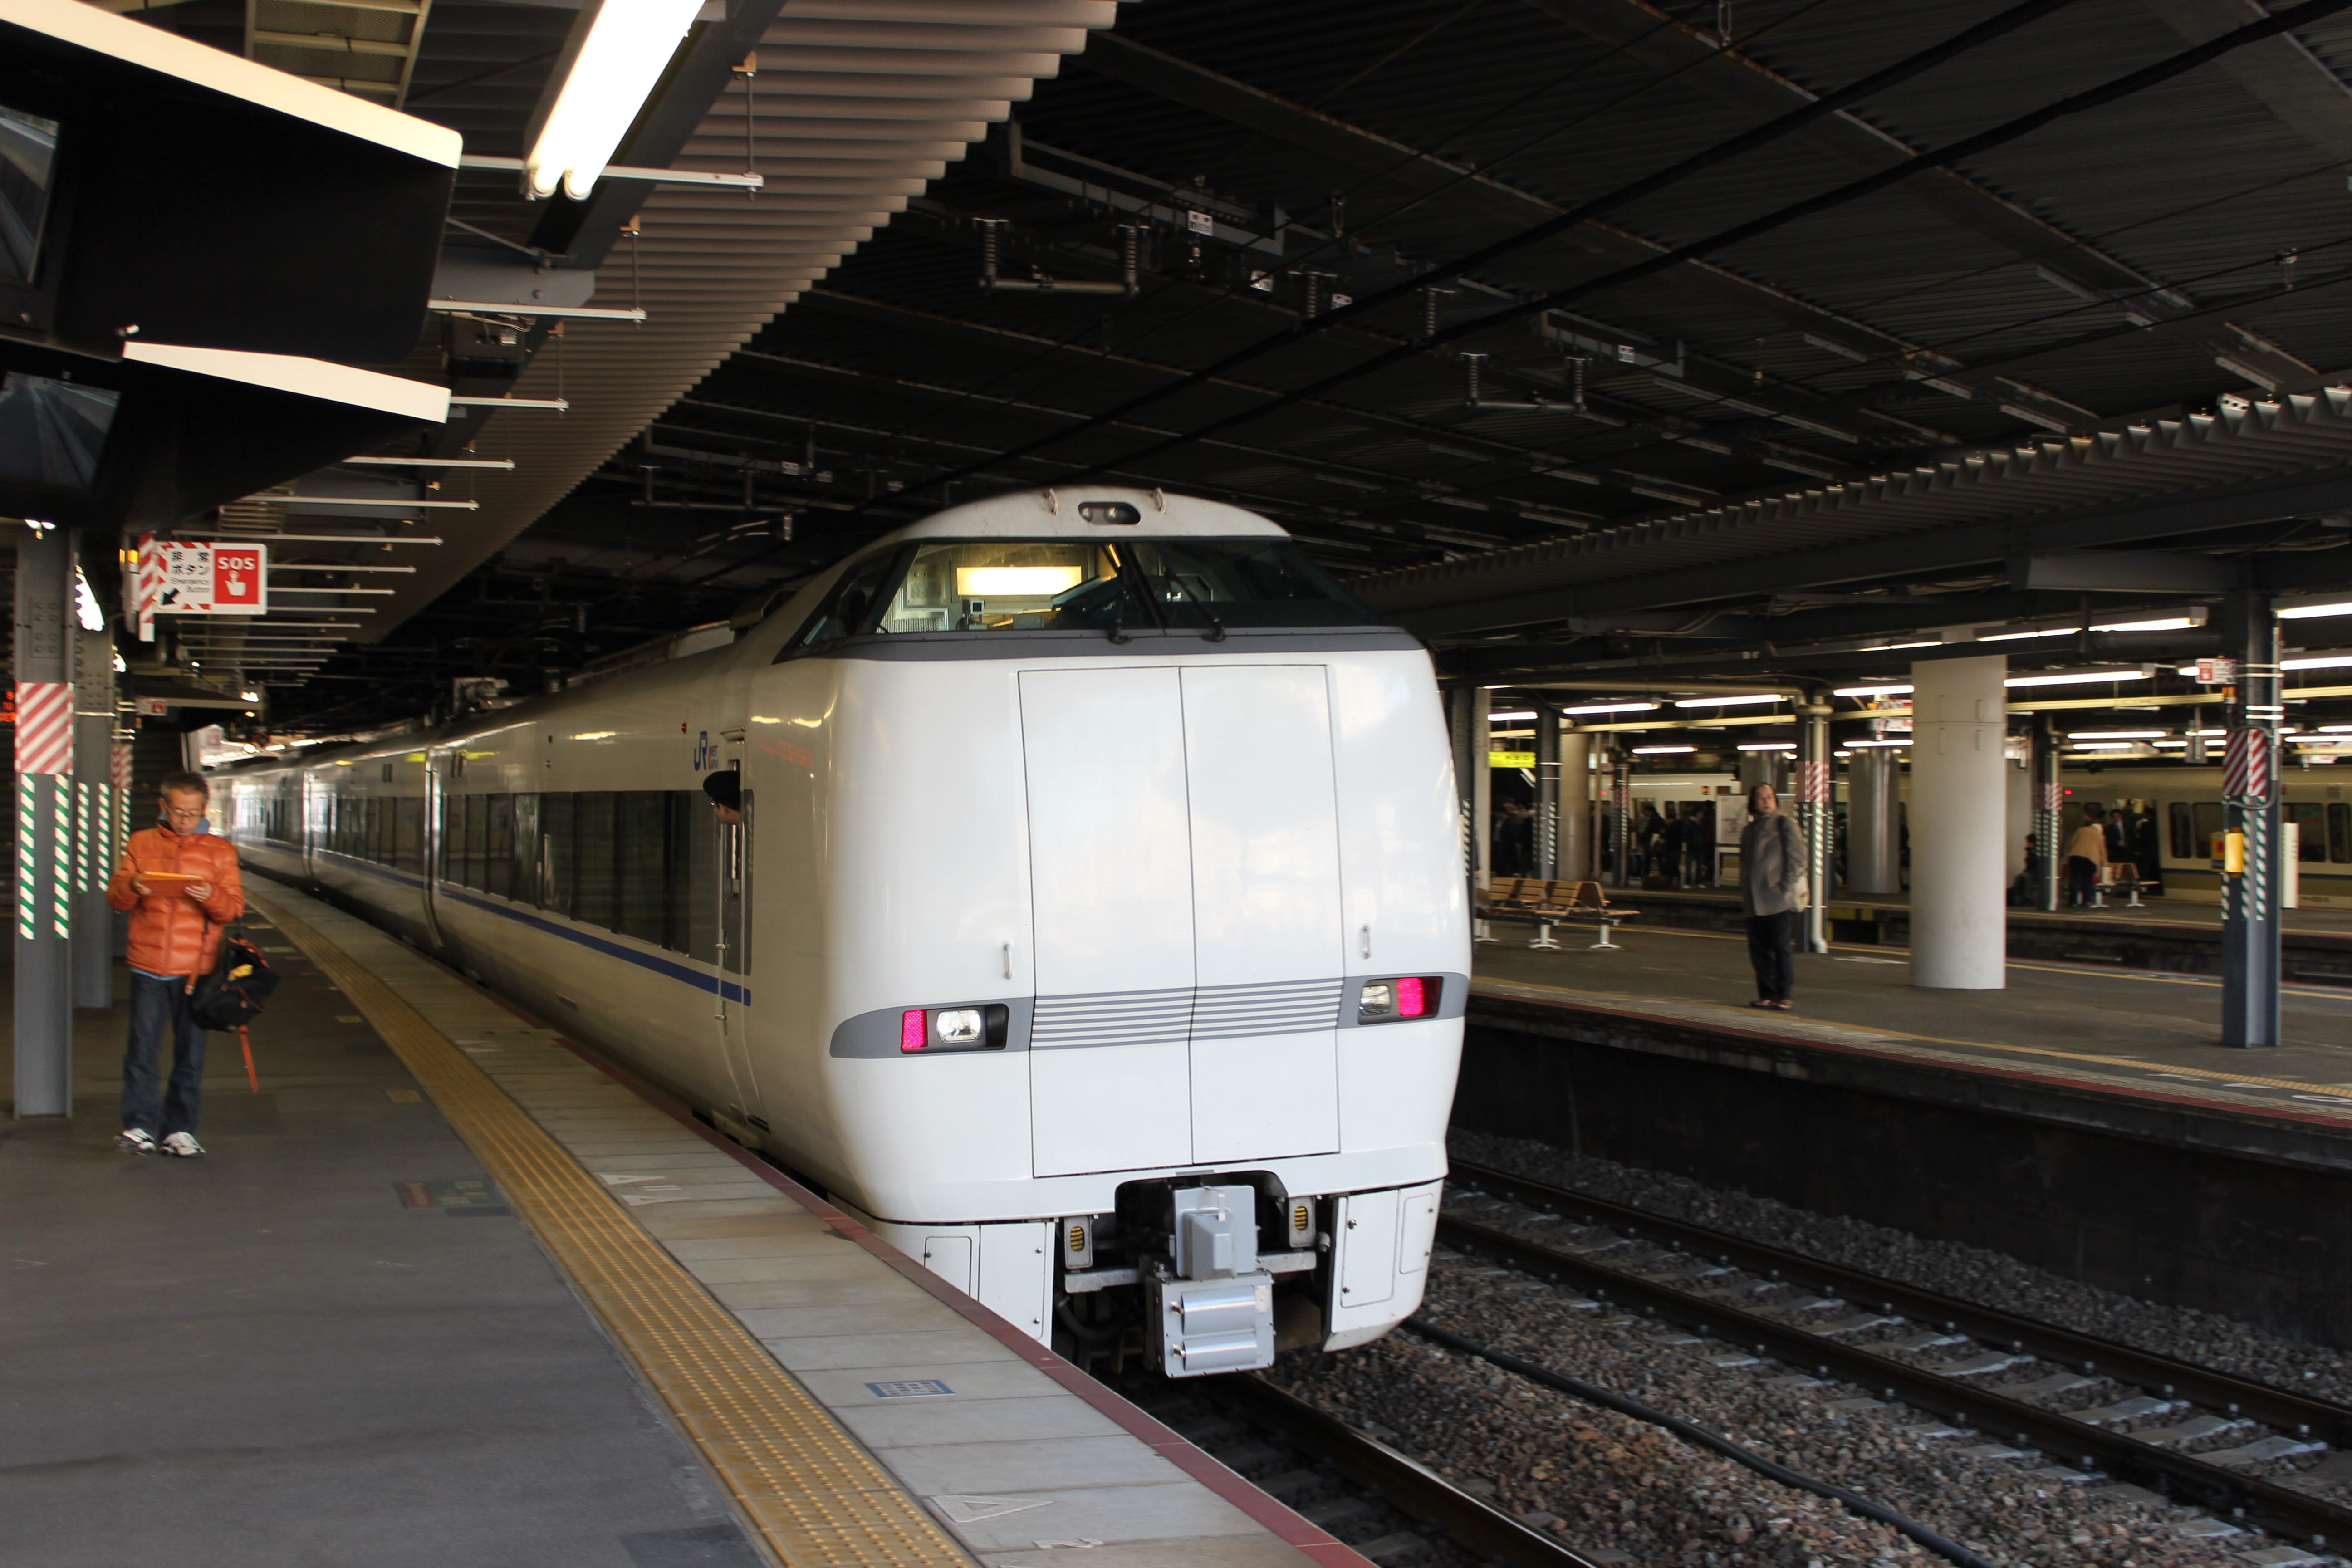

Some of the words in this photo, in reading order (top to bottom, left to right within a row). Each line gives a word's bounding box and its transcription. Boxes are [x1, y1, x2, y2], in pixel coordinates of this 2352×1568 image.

[171, 564, 211, 575] ボタン
[217, 557, 255, 570] SOS
[694, 731, 708, 772] JR
